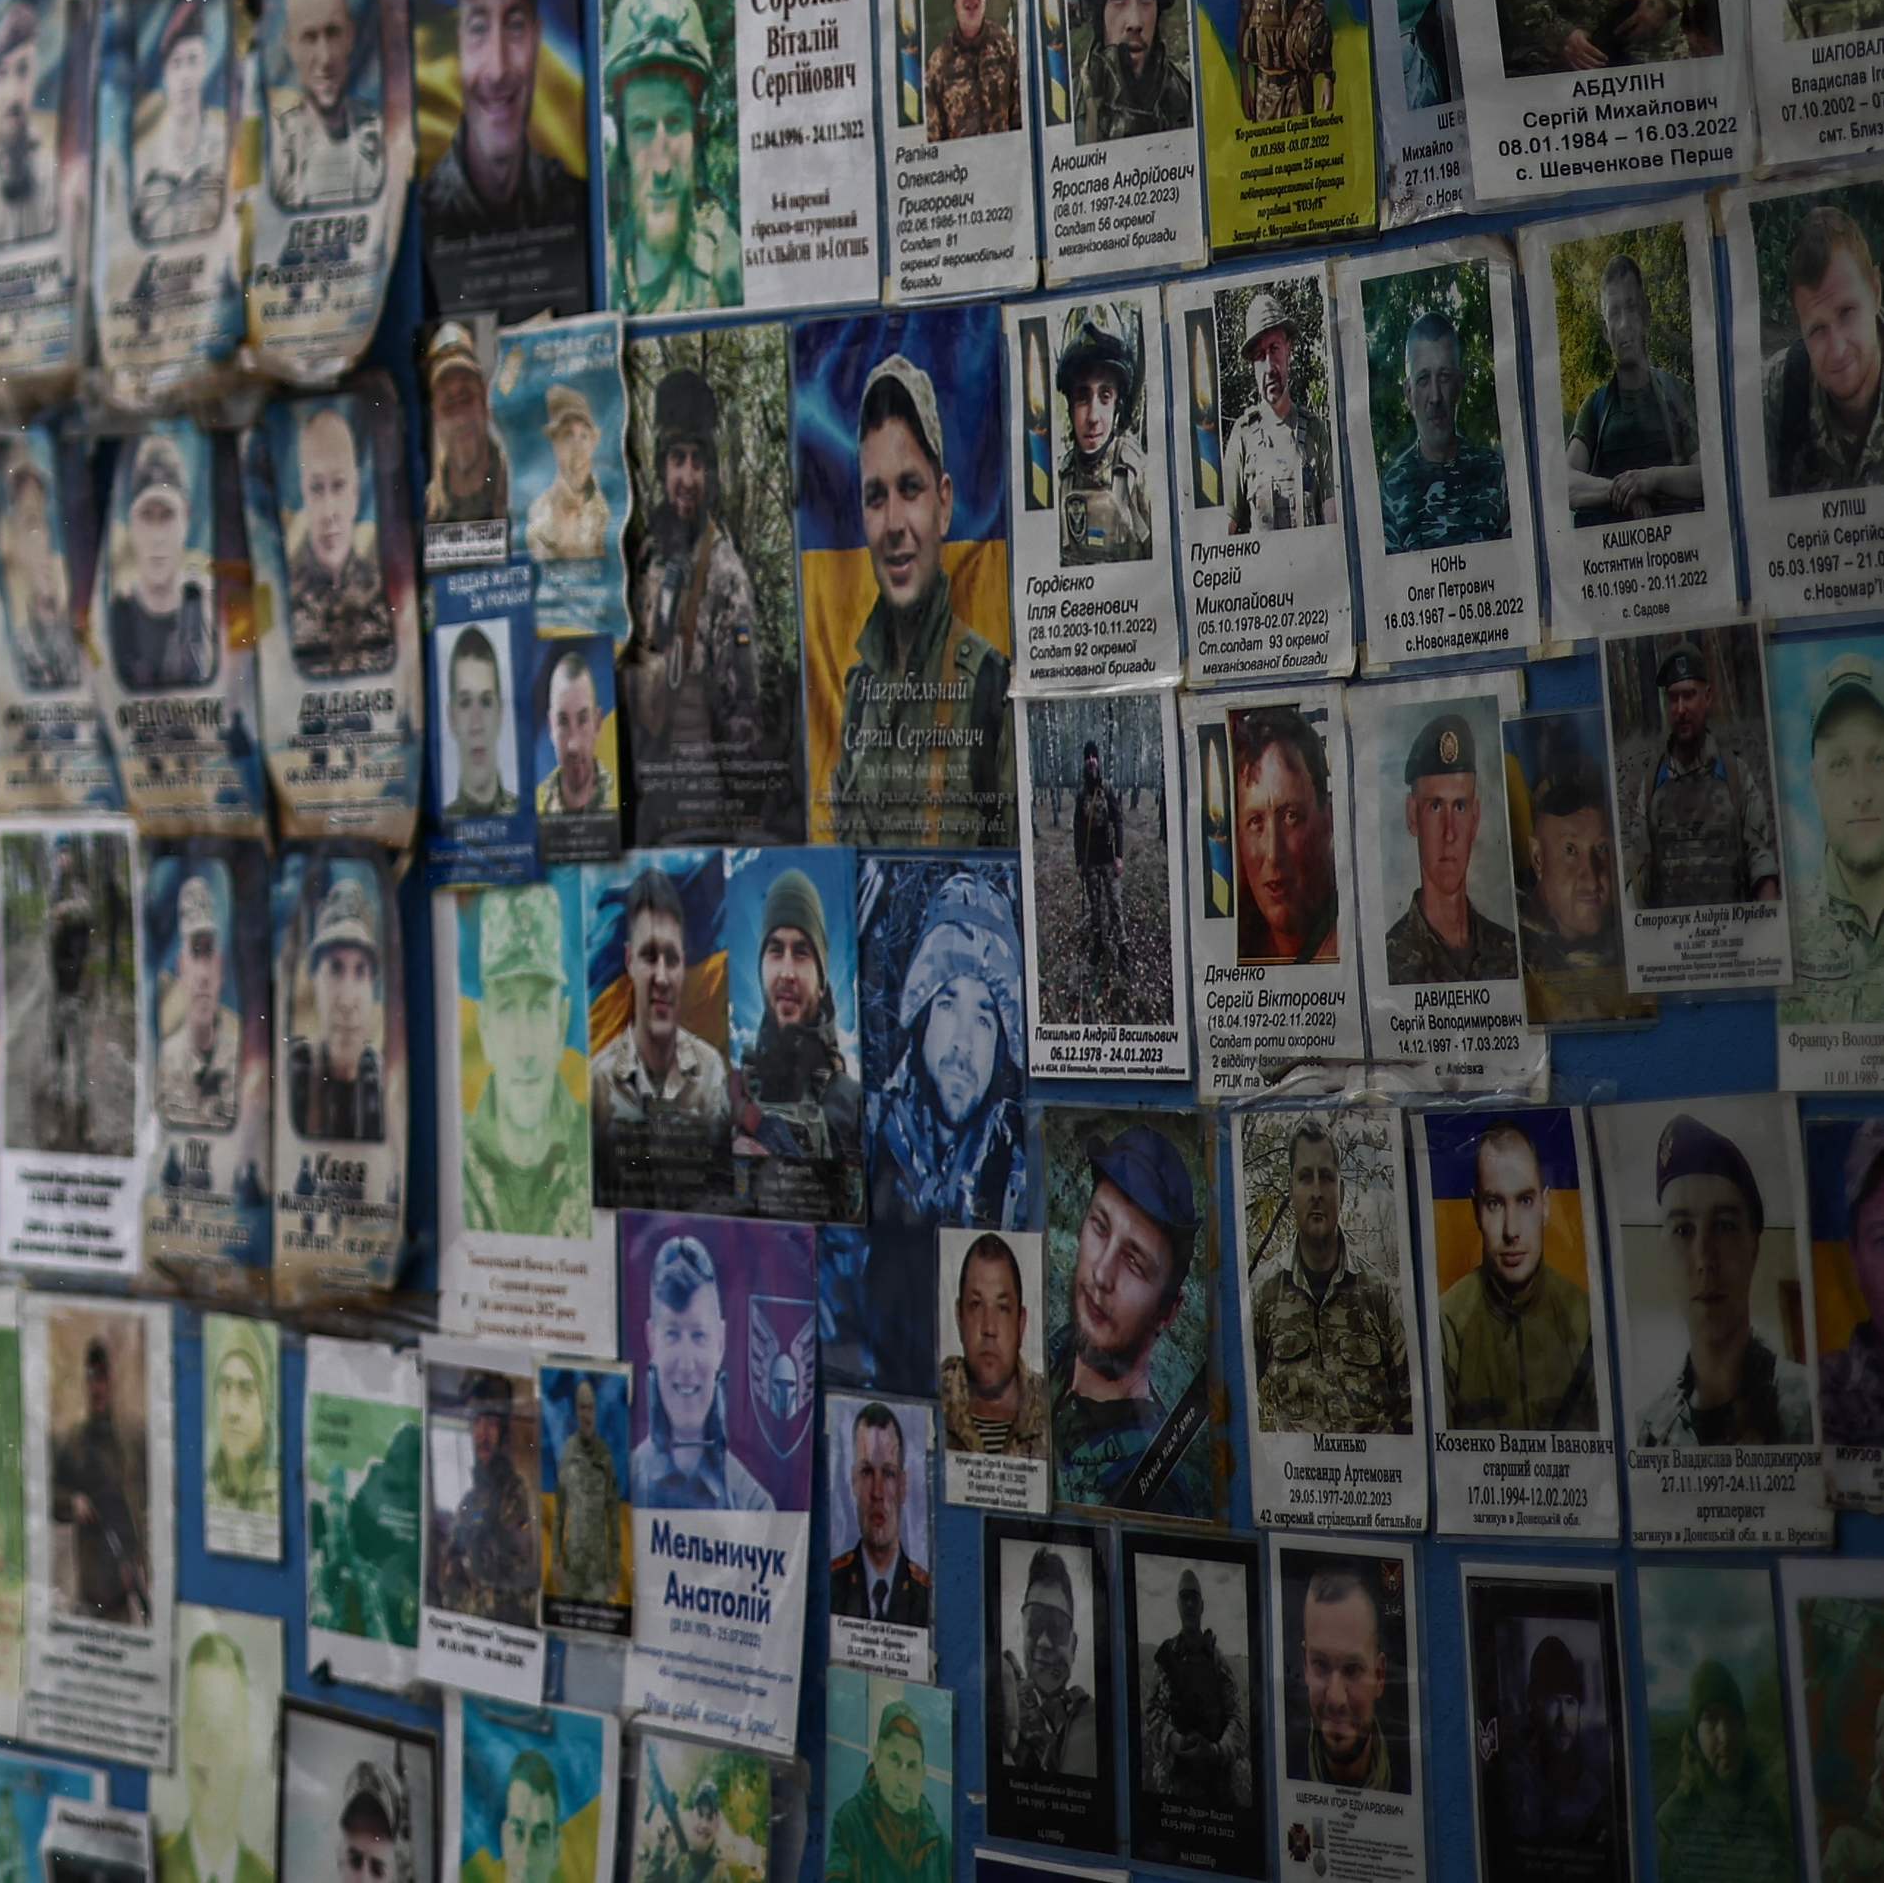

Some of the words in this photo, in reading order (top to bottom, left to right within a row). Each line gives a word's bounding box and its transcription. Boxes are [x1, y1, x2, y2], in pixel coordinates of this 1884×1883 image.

[766, 18, 841, 58] Віталій
[752, 60, 857, 107] Сергійович
[1572, 73, 1665, 98] АБДУЛІН
[1792, 72, 1867, 94] Владислав
[1523, 108, 1589, 129] Сергій
[1595, 97, 1718, 121] Михайлович
[1782, 96, 1855, 122] 07.10.2002
[1499, 131, 1608, 156] 08.01.1984
[1635, 117, 1738, 143] 16.03.2022
[895, 145, 939, 165] Рапіна
[1052, 149, 1107, 173] Аношкін
[1402, 141, 1453, 163] Михайло
[1515, 165, 1533, 181] с.
[1540, 154, 1663, 180] Шевченкове
[1671, 146, 1733, 168] Перше
[897, 165, 969, 190] Олександр
[1052, 178, 1109, 201] Ярослав
[1113, 164, 1194, 188] Андрійович
[899, 192, 974, 216] Григорович
[1055, 219, 1095, 238] Солдат
[1113, 211, 1155, 231] окремої
[1059, 232, 1130, 257] механізованої
[1132, 228, 1176, 246] бригади
[1822, 498, 1865, 519] КУЛІШ
[1602, 525, 1673, 550] КАШКОВАР
[1787, 529, 1829, 551] Сергій
[1191, 539, 1260, 564] Пупченко
[1582, 558, 1644, 576] Костянтин
[1646, 548, 1700, 570] Ігорович
[1430, 555, 1467, 574] НОНЬ
[1769, 555, 1840, 578] 05.03.1997
[1026, 575, 1094, 597] Гордієнко
[1193, 567, 1242, 590] Сергій
[1581, 579, 1638, 601] 16.10.1990
[1648, 570, 1708, 592] 20.11.2022
[1196, 591, 1293, 615] Миколайович
[1407, 583, 1435, 604] Олег
[1438, 579, 1495, 601] Петрович
[1027, 603, 1056, 621] Ілля
[1061, 598, 1139, 617] Євгенович
[1384, 607, 1445, 630] 16.03.1967
[1459, 597, 1524, 620] 05.08.2022
[1633, 602, 1670, 619] Садове
[1028, 621, 1157, 643] (28.10.2003-10.11.2022)
[1197, 610, 1329, 638] (05.10.1978-02.07.2022)
[1030, 643, 1072, 659] Солдат
[1074, 643, 1089, 656] 92
[1091, 641, 1137, 661] окремої
[1269, 635, 1283, 650] 93
[1286, 630, 1330, 651] окремої
[1405, 628, 1510, 653] с.Новонадеждине
[1108, 659, 1156, 679] бригади
[1202, 653, 1280, 676] механізованої
[1282, 651, 1329, 671] бригади
[857, 671, 969, 709] Нагребельний
[843, 724, 892, 755] Сергій
[896, 721, 984, 756] Сергійович
[1635, 913, 1691, 931] Сторожук
[1693, 908, 1730, 926] Андрій
[1732, 905, 1777, 924] Юрієвич
[1204, 966, 1265, 986] Дяченко
[1206, 992, 1254, 1011] Сергій
[1258, 989, 1346, 1009] Вікторович
[1415, 989, 1490, 1010] ДАВИДЕНКО
[1208, 1012, 1336, 1030] (18.04.1972-02.11.2022)
[1390, 1015, 1425, 1034] Сергій
[1428, 1014, 1522, 1031] Володимирович
[1083, 1028, 1116, 1044] Андрій
[1210, 1035, 1251, 1050] Солдат
[1254, 1037, 1285, 1052] роти
[1287, 1036, 1335, 1050] охорони
[1399, 1038, 1451, 1053] 14.12.1997
[1462, 1036, 1520, 1052] 17.03.2023
[1789, 1032, 1839, 1052] Француз
[1050, 1048, 1102, 1062] 06.12.1978
[1111, 1048, 1163, 1063] 24.01.2023
[1212, 1055, 1219, 1068] 2
[1313, 1434, 1367, 1453] Махинько
[1435, 1433, 1495, 1453] Козенко
[1500, 1434, 1547, 1455] Вадим
[1551, 1434, 1614, 1455] Іванович
[1483, 1460, 1531, 1481] старший
[1533, 1462, 1570, 1479] солдат
[1628, 1449, 1669, 1472] Синчук
[1673, 1449, 1732, 1468] Владислав
[1138, 1458, 1162, 1497] Вічна
[1284, 1461, 1341, 1486] Олександр
[1344, 1464, 1403, 1484] Артемович
[1661, 1475, 1796, 1493] 27.11.1997-24.11.2022
[1290, 1491, 1392, 1506] 29.05.1977-20.02.2023
[1468, 1487, 1588, 1507] 17.01.1994-12.02.2023
[1260, 1510, 1272, 1523] 42
[1274, 1513, 1314, 1529] окремий
[1316, 1510, 1372, 1529] стрілецький
[1473, 1512, 1507, 1526] загинув
[1697, 1505, 1765, 1524] артилерист
[651, 1517, 786, 1584] Мельничук
[664, 1571, 771, 1625] Анатолій
[1295, 1791, 1329, 1806] ЩЕРБАК
[1330, 1794, 1347, 1809] ІГОР
[1349, 1796, 1404, 1817] ЕДУАРДОВИЧ
